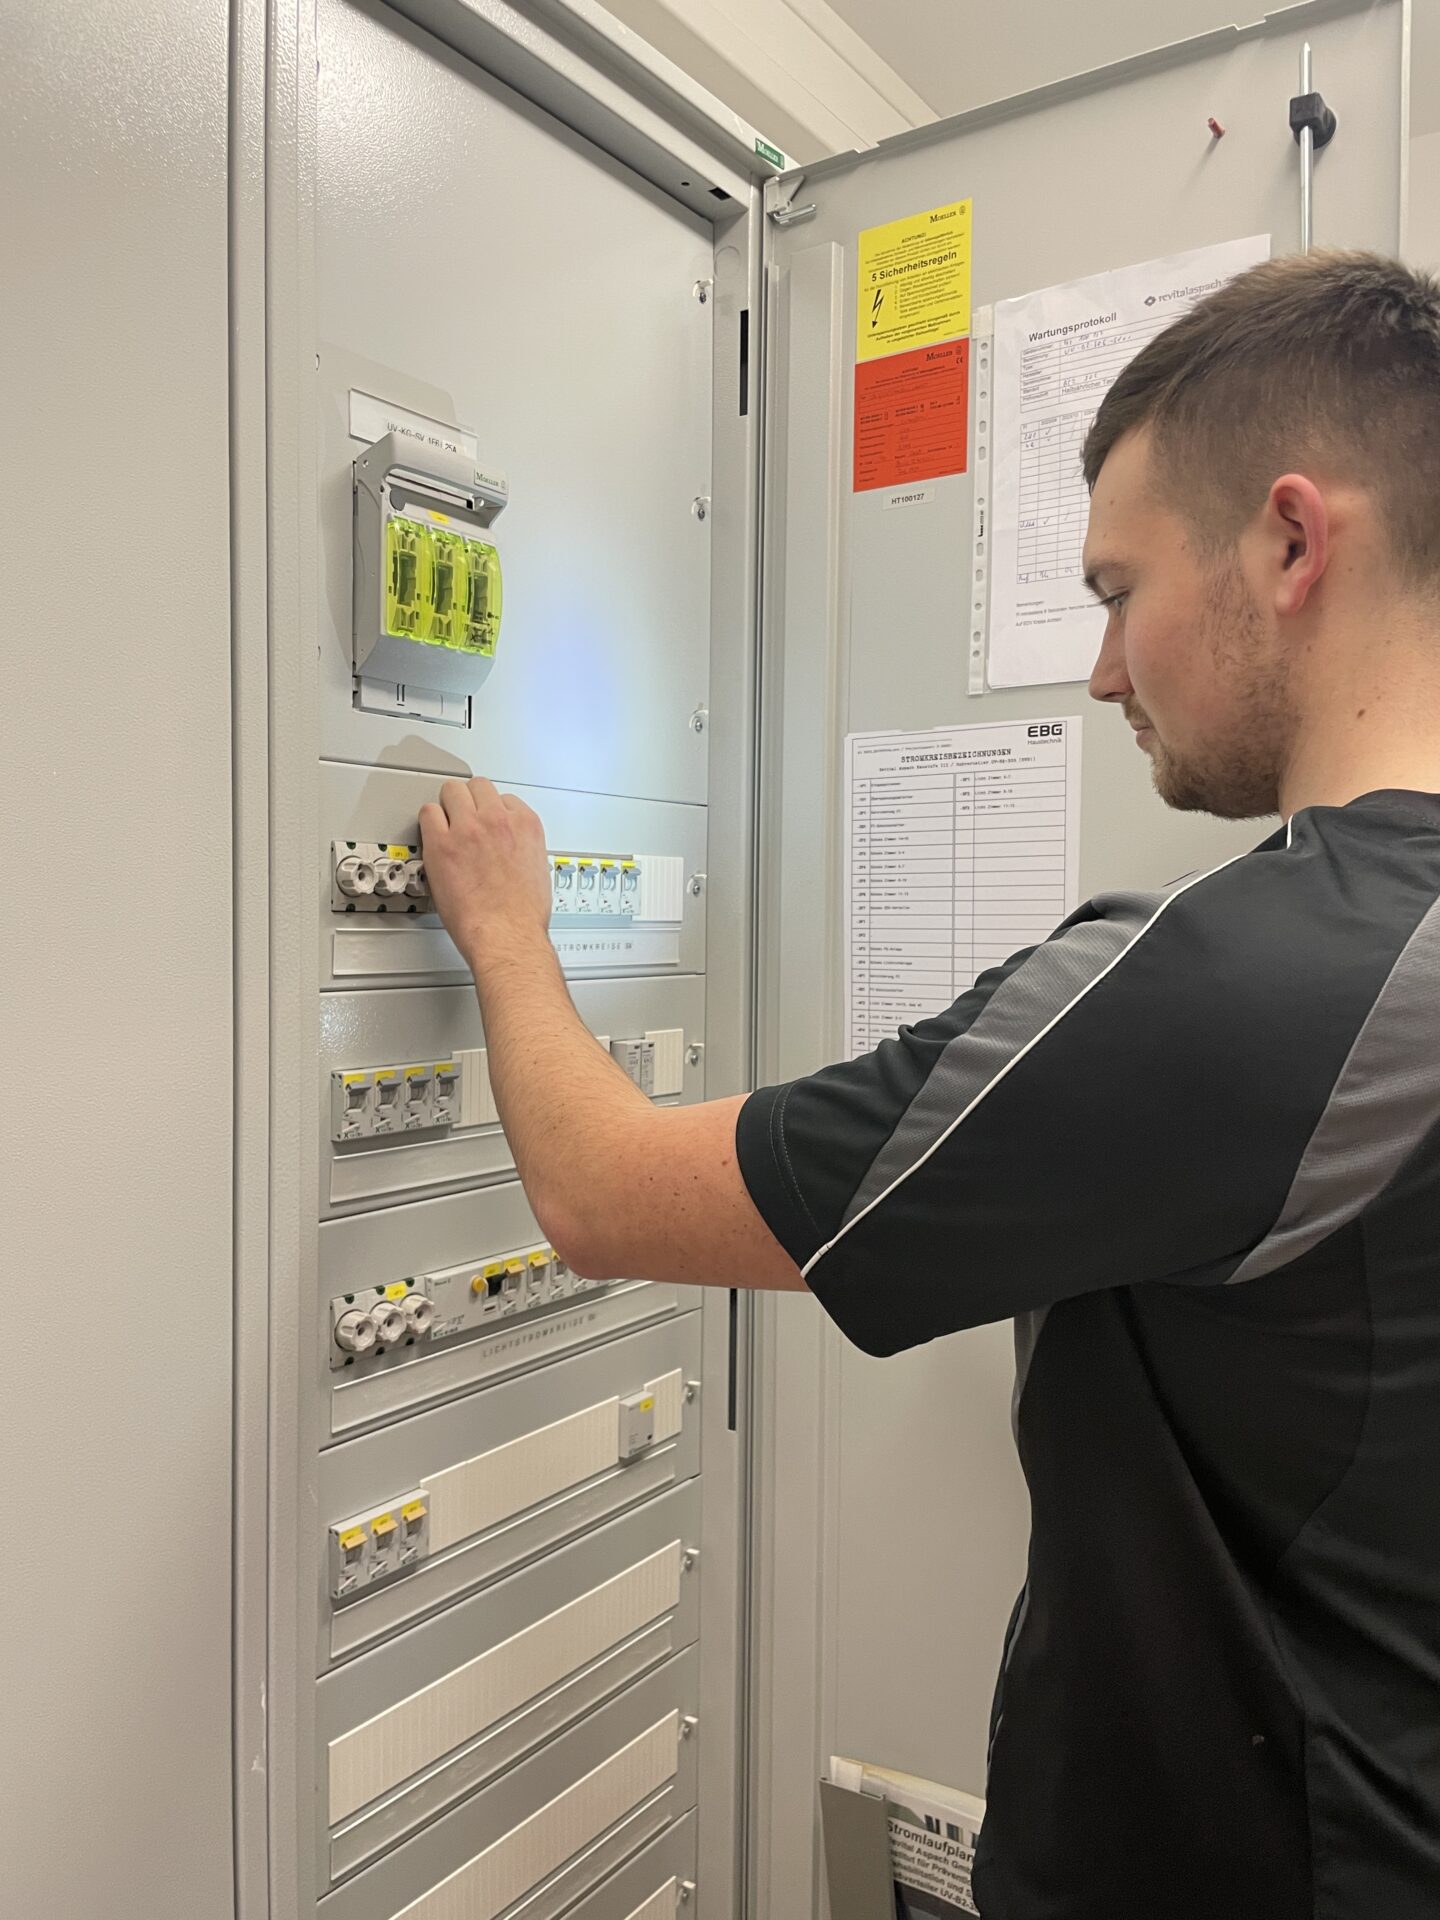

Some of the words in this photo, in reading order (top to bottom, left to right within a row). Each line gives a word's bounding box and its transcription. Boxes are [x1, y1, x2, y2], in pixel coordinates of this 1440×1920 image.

[871, 273, 877, 282] 5
[880, 251, 957, 280] Sicherheitsregeln
[1028, 312, 1117, 342] Wartungsprotokoll
[891, 493, 925, 505] HT100127
[1027, 723, 1063, 738] EBG
[1027, 737, 1062, 746] Haustechnik
[901, 748, 1012, 763] STROMKREISBEZEICHNUNGEN
[916, 1847, 949, 1865] Aspach
[932, 1863, 971, 1886] Präventio
[940, 1888, 975, 1910] UV-B2-3
